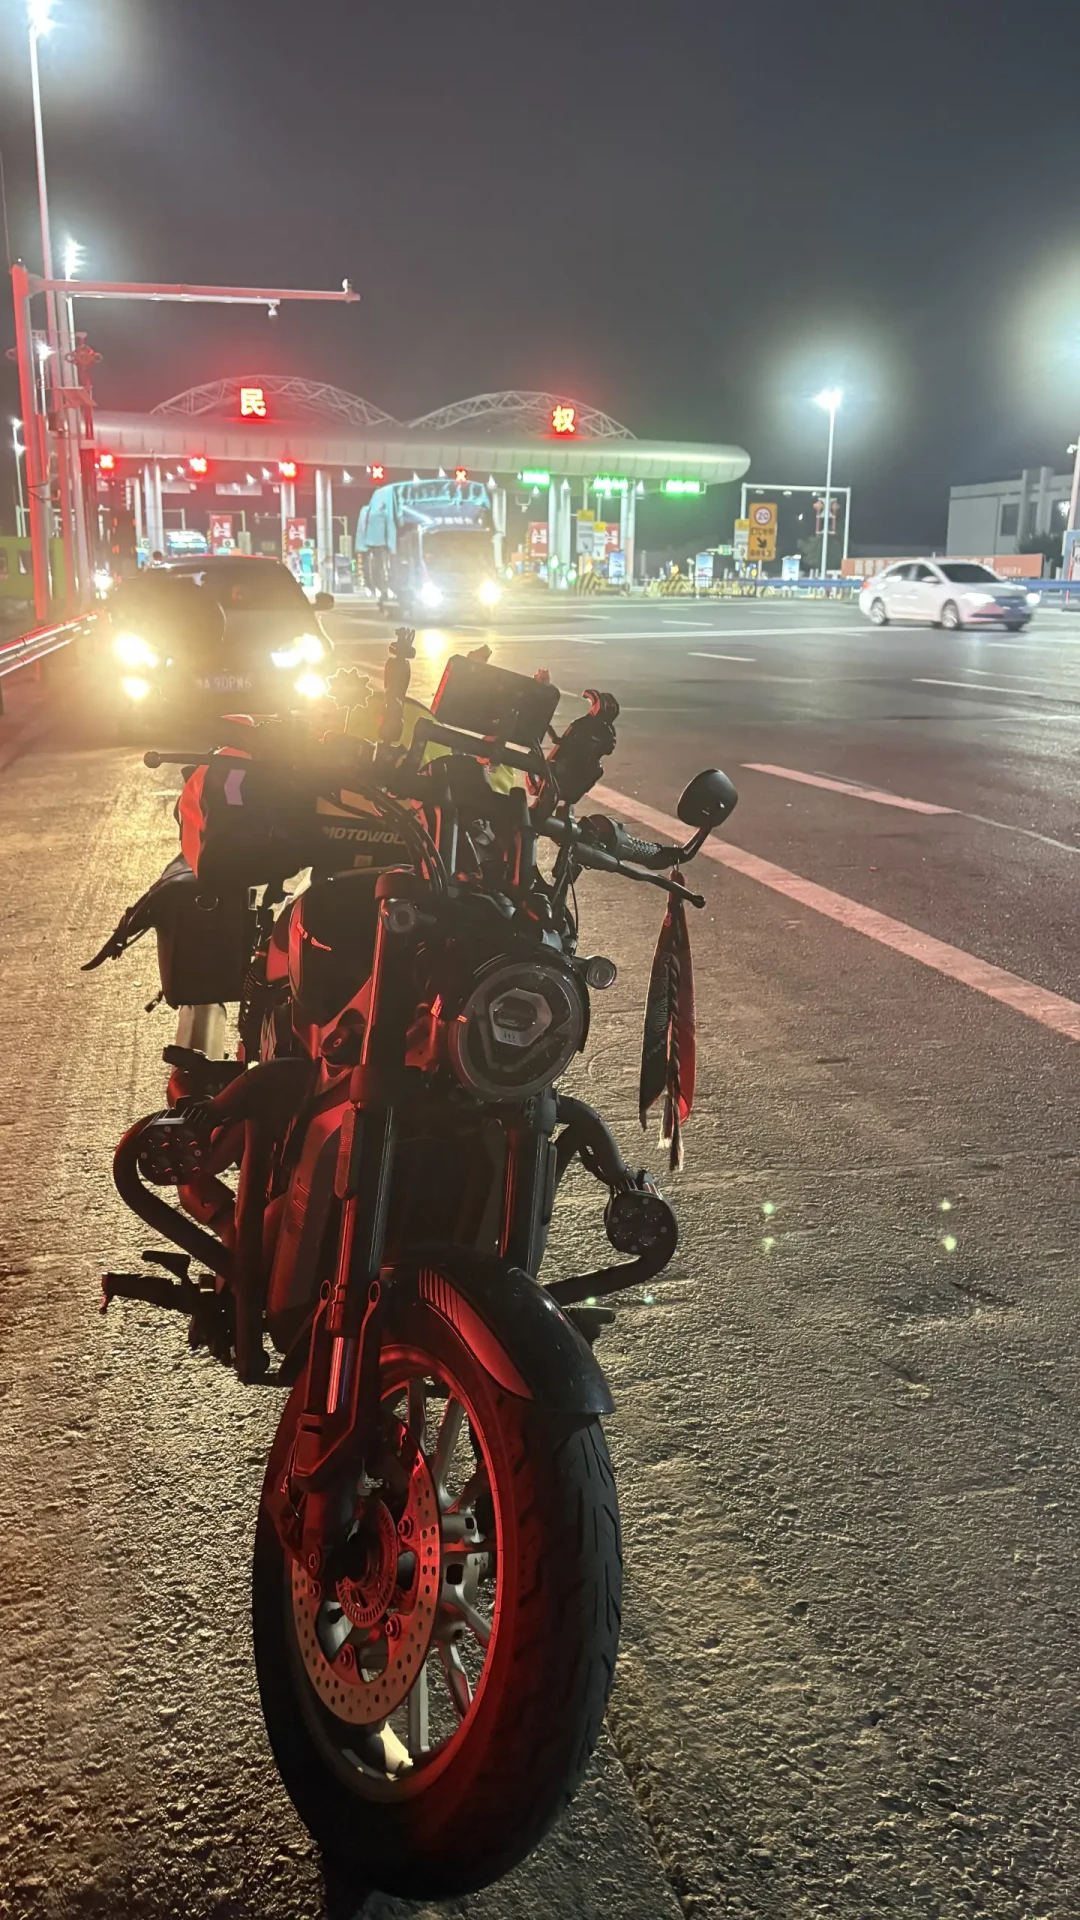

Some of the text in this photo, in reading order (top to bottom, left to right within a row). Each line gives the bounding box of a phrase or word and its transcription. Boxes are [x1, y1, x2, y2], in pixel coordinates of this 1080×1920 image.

[240, 387, 267, 417] 民
[552, 404, 576, 433] 权
[758, 512, 769, 521] 20
[322, 825, 407, 845] MOTOWOL
